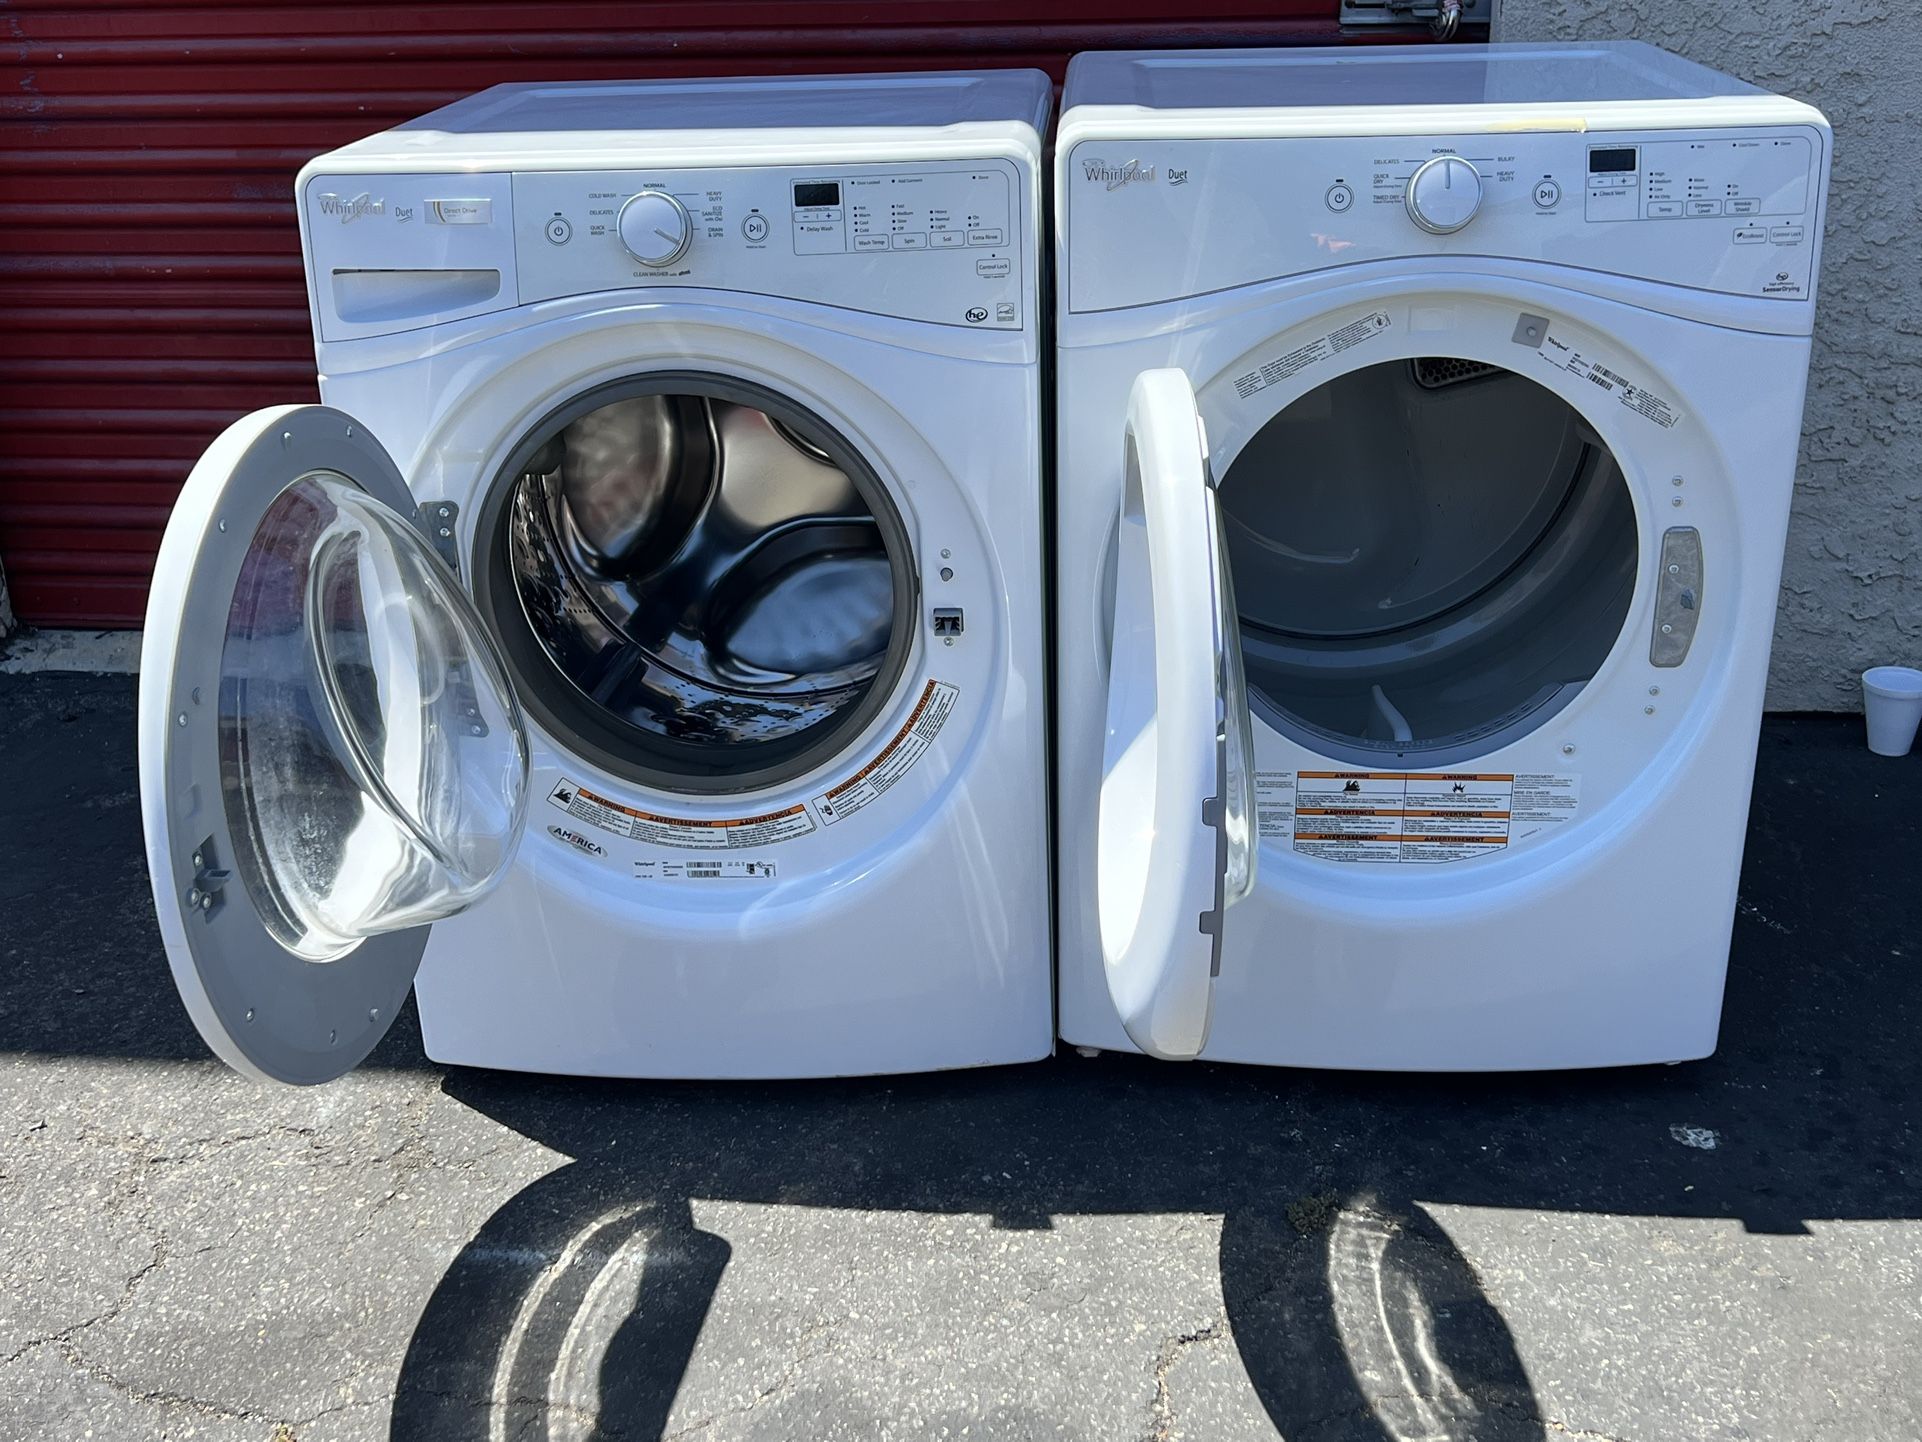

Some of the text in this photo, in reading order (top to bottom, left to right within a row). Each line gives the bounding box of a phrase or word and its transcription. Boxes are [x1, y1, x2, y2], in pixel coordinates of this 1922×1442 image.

[1084, 160, 1156, 189] Whirlpool
[1168, 168, 1188, 181] Duet
[318, 193, 387, 224] Whirlpool
[395, 206, 414, 218] Duet
[1762, 285, 1801, 294] SensorDrying
[1338, 772, 1370, 780] WARNING
[592, 794, 626, 813] WARNING
[655, 815, 713, 828] AVERTISSEMENT
[745, 809, 793, 825] ADVERTENCIA
[553, 826, 602, 855] AMERICA
